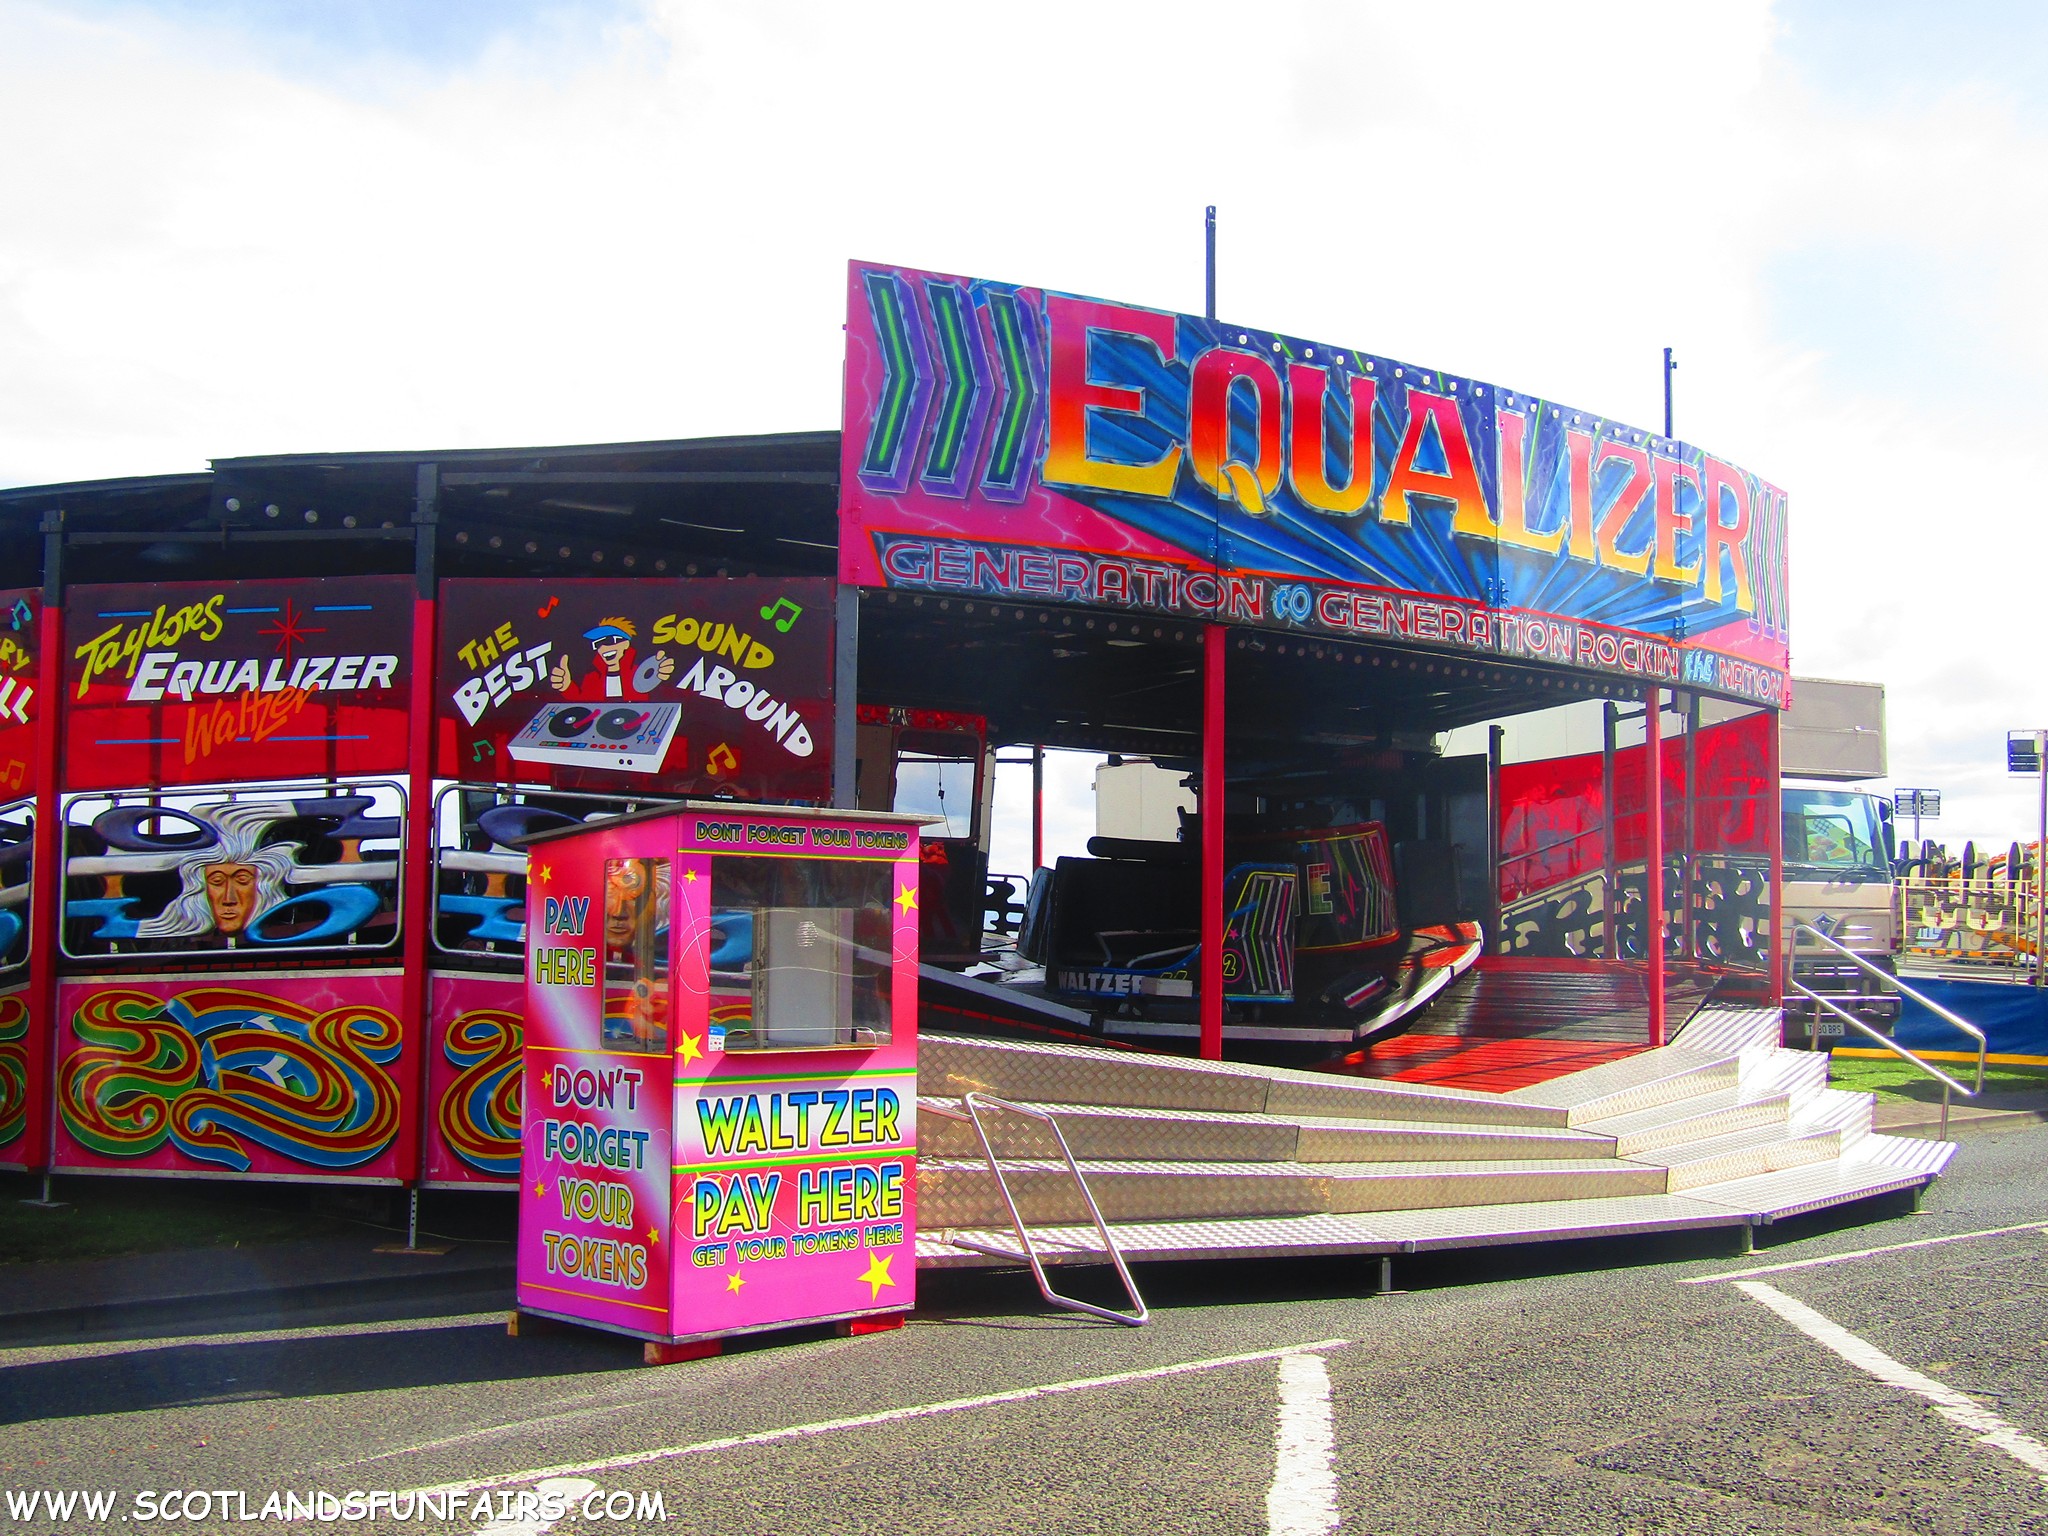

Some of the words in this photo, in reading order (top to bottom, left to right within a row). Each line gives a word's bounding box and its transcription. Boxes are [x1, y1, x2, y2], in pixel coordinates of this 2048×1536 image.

[1038, 290, 1756, 620] EQUALIZER
[456, 620, 521, 671] THE
[652, 614, 776, 669] SOUND
[880, 538, 1264, 620] GENERATION
[1270, 583, 1314, 622] to
[1316, 587, 1573, 660] GENERATION
[1575, 626, 1681, 681] ROCKIN
[1685, 648, 1718, 683] the
[1718, 655, 1784, 703] NATION
[0, 636, 32, 671] RY
[126, 651, 400, 703] EQUALIZER
[0, 676, 34, 725] LL
[451, 640, 554, 728] BEST
[675, 656, 814, 759] AROUND
[184, 682, 320, 766] Waltzer
[696, 821, 743, 843] DONT
[747, 824, 806, 845] FORGET
[811, 828, 851, 848] YOUR
[855, 831, 909, 850] TOKENS
[1296, 862, 1333, 915] E
[544, 895, 591, 936] PAY
[535, 947, 597, 988] HERE
[1222, 953, 1238, 977] 2
[554, 1066, 643, 1111] DON'T
[544, 1121, 650, 1171] FORGET
[696, 1087, 901, 1155] WALTZER
[558, 1178, 634, 1230] YOUR
[694, 1173, 781, 1238] PAY
[799, 1164, 903, 1226] HERE
[542, 1233, 648, 1290] TOKENS
[691, 1242, 729, 1267] GET
[735, 1235, 787, 1264] YOUR
[792, 1229, 859, 1257] TOKENS
[864, 1223, 904, 1248] HERE
